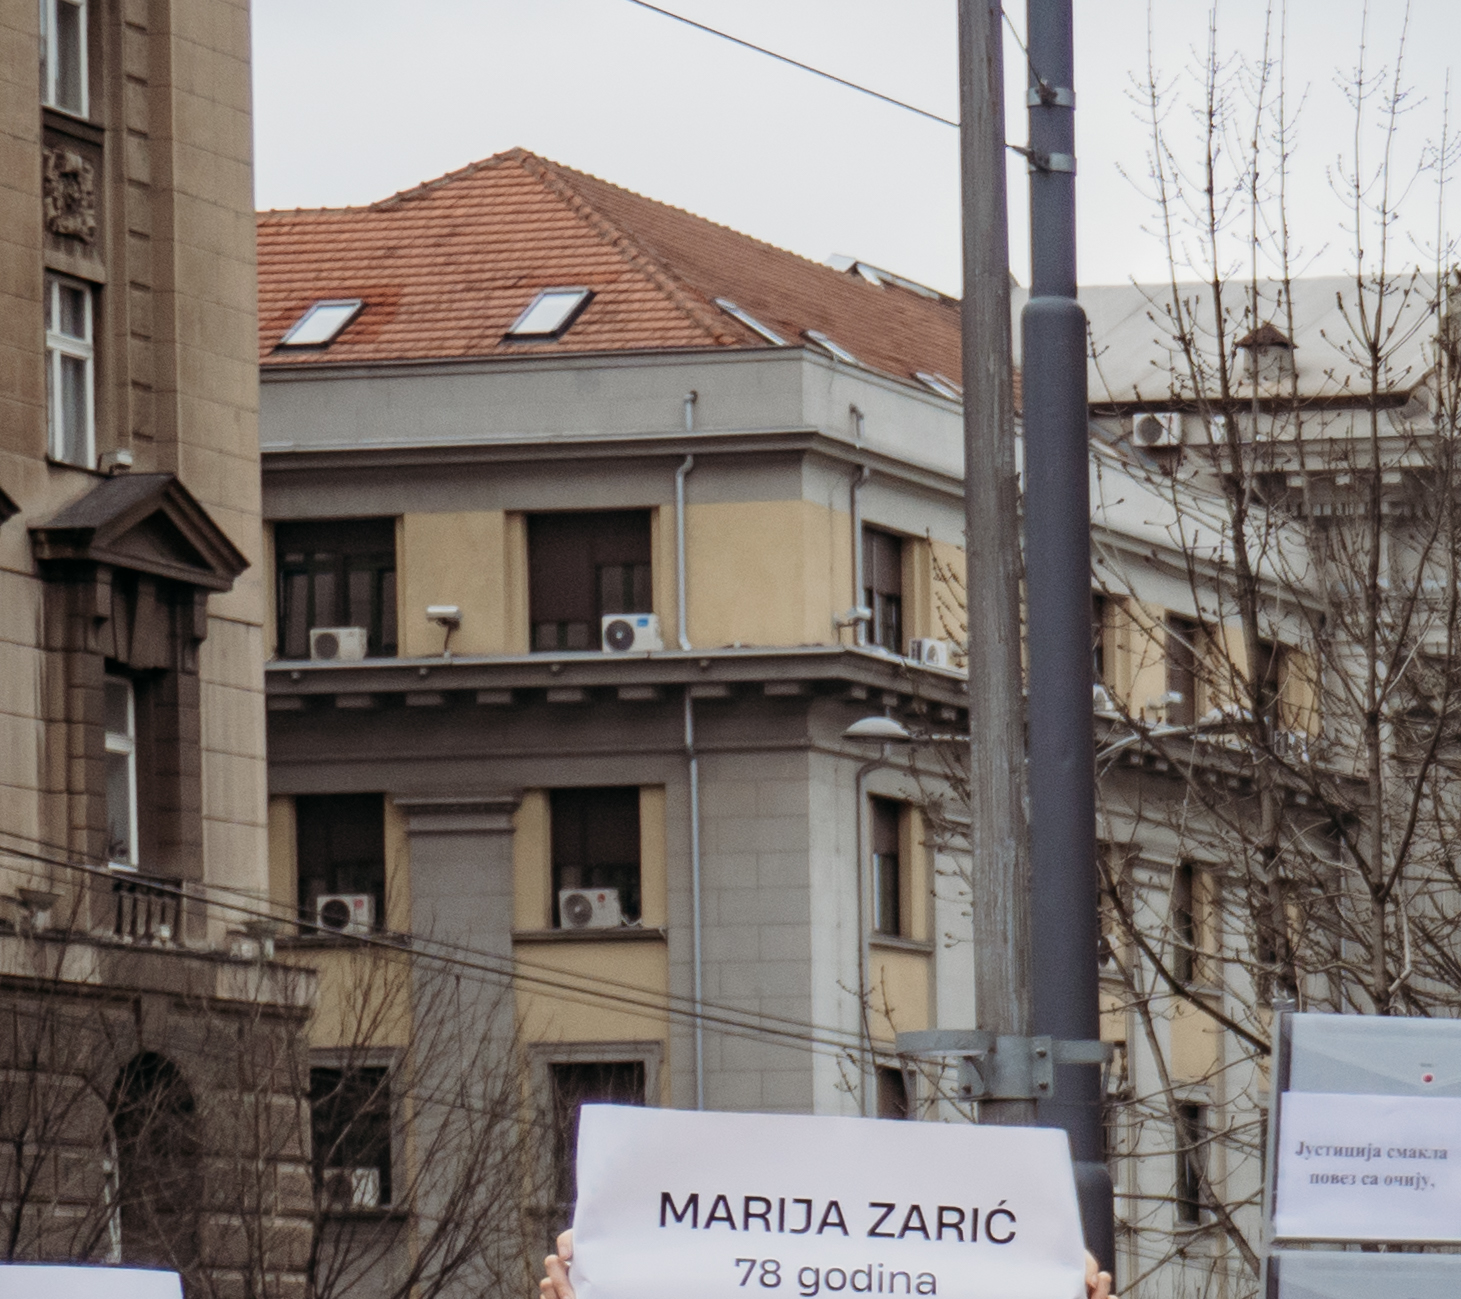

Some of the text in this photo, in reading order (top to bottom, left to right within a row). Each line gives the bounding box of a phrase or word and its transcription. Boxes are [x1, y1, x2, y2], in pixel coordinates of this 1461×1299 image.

[1295, 1142, 1447, 1162] Јустиција смакла
[1310, 1172, 1435, 1191] повез са очију,
[660, 1192, 1016, 1244] MARIJA ZARIĆ
[736, 1258, 936, 1297] 78 godina
